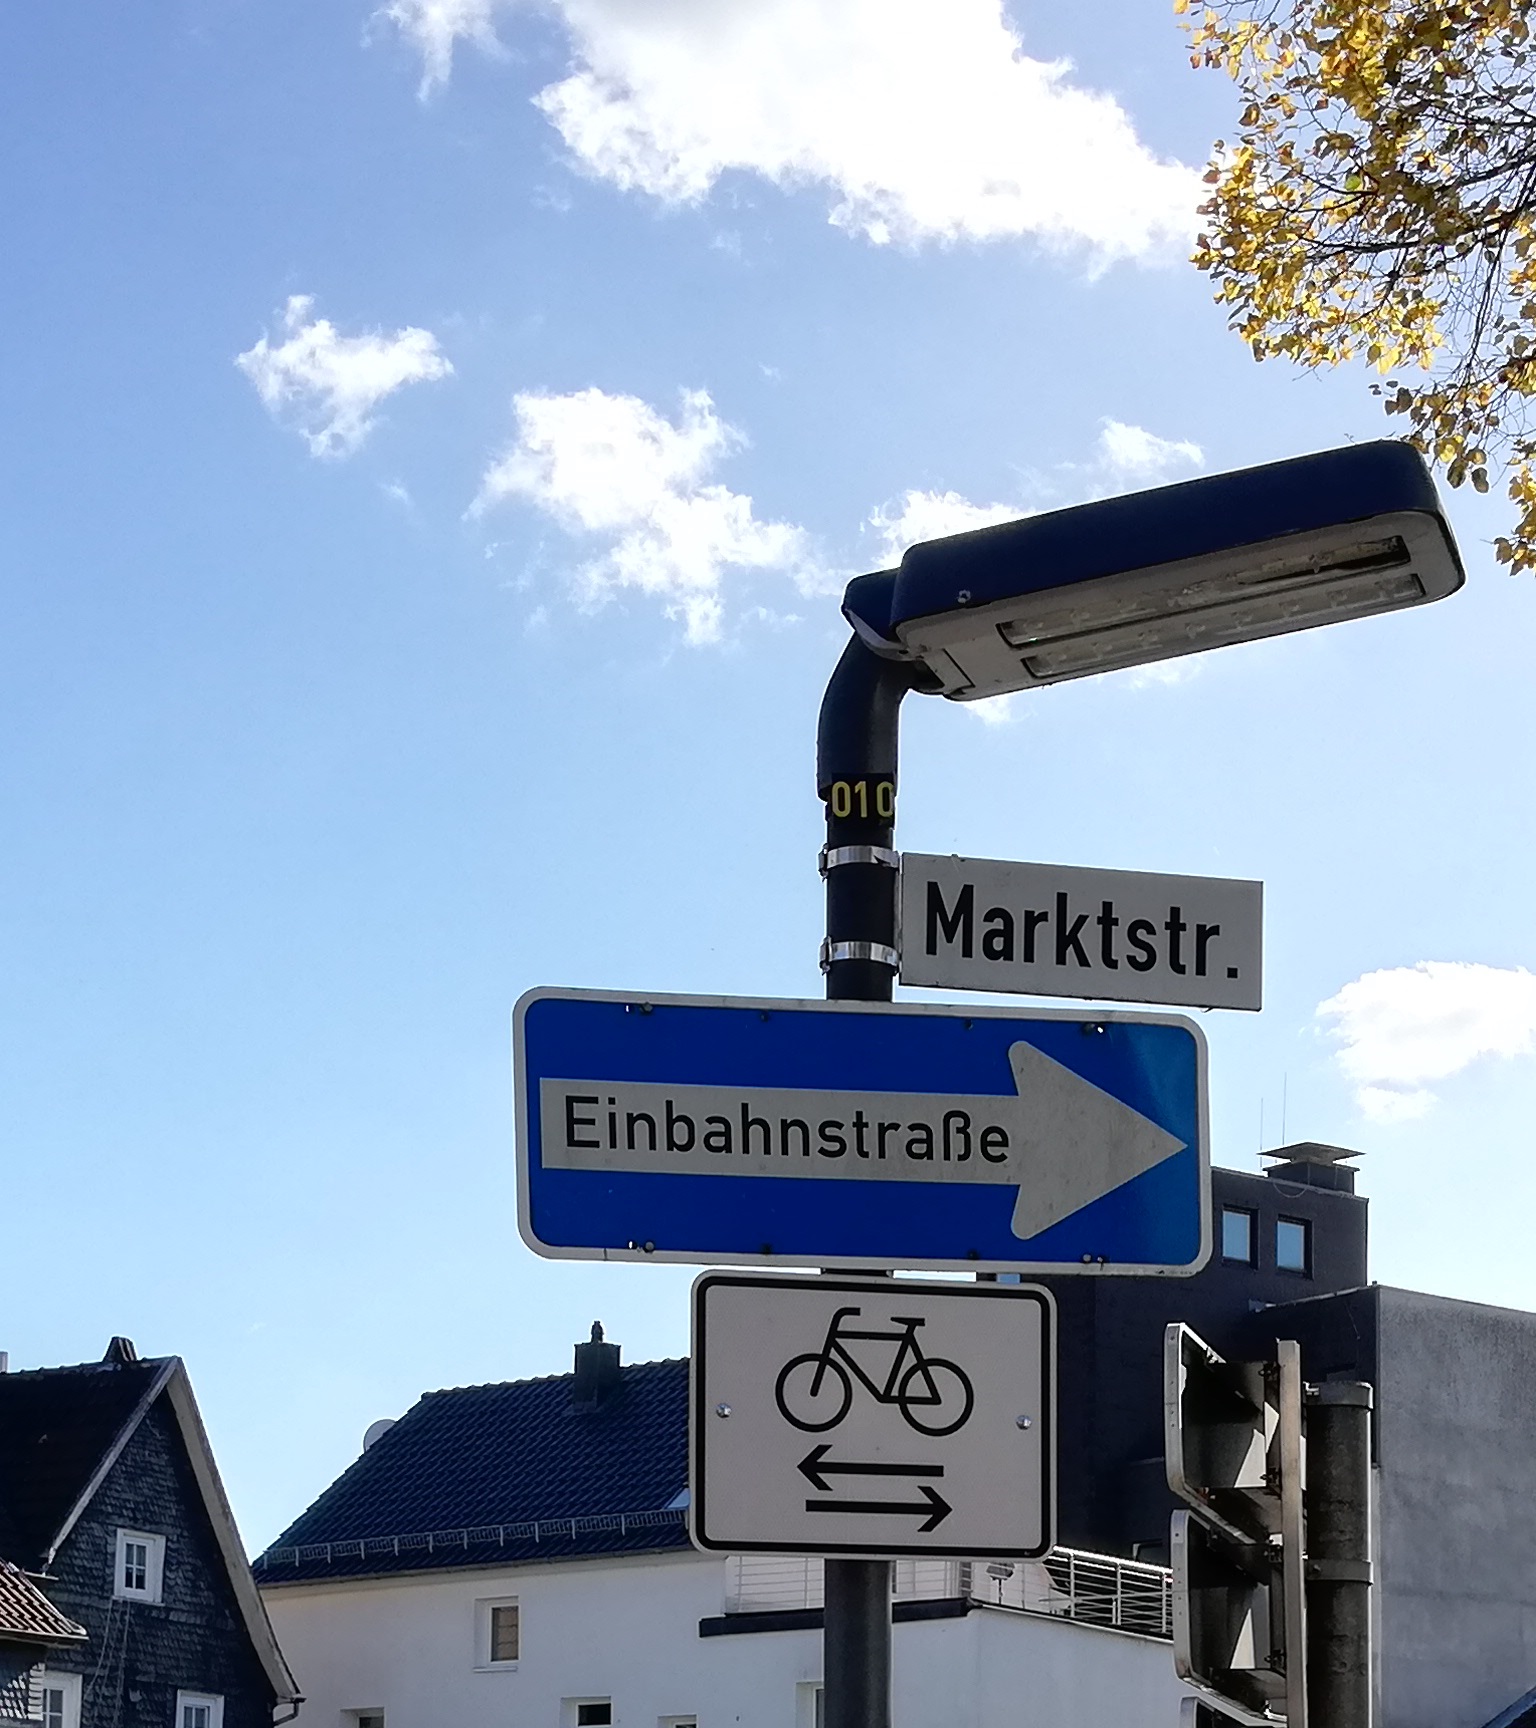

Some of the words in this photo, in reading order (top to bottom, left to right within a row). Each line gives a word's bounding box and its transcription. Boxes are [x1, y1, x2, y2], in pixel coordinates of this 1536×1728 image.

[831, 780, 895, 818] 010
[925, 880, 1239, 979] Marktstr.
[565, 1094, 1010, 1164] Einbahnstraße
